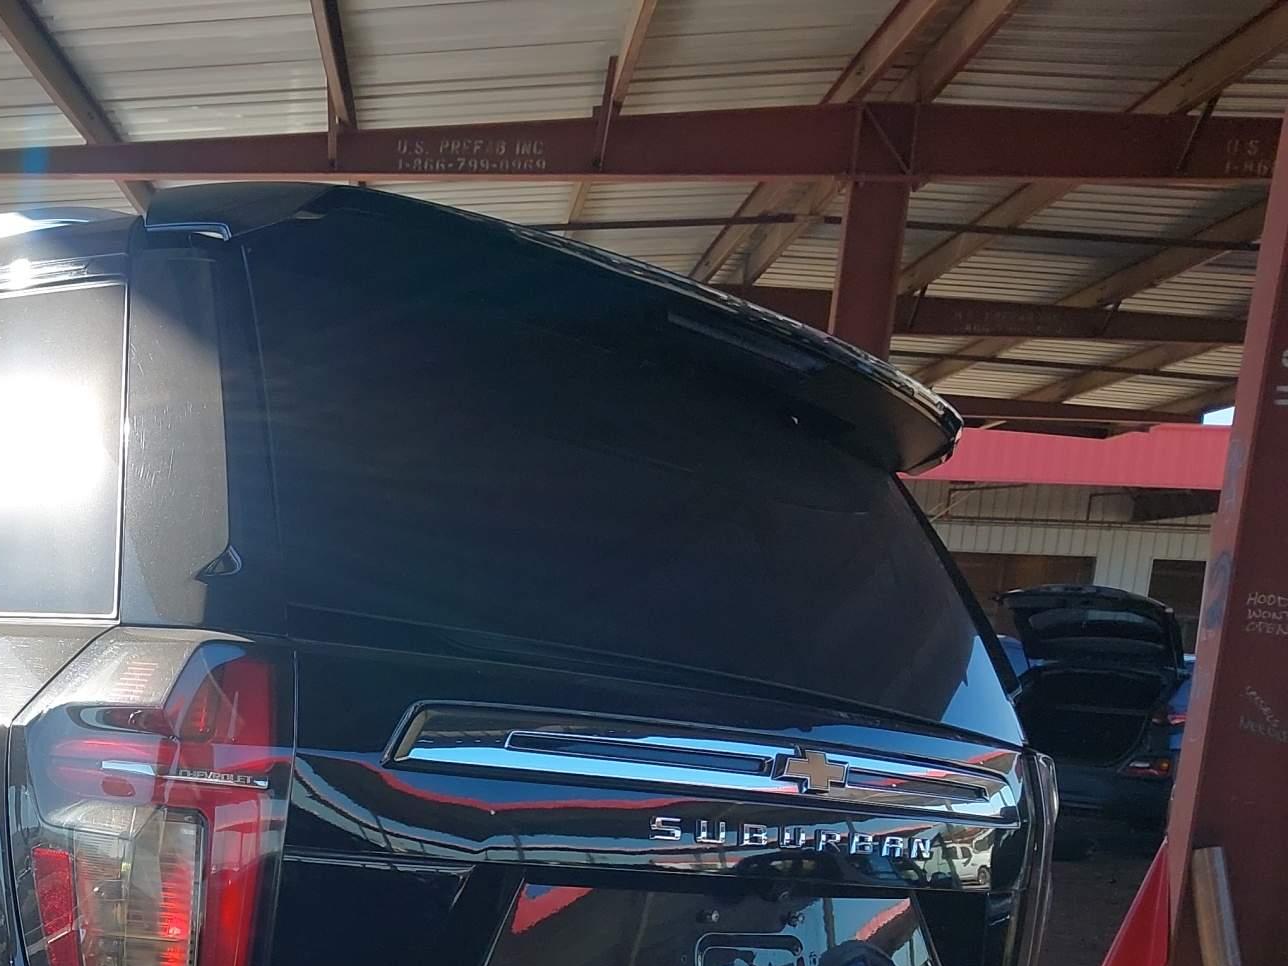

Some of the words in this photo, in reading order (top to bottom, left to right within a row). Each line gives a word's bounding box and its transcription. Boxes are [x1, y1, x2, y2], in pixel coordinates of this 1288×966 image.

[397, 139, 429, 155] U.S.
[178, 768, 252, 784] CHEVROLET
[649, 815, 934, 860] SUBURBAN
